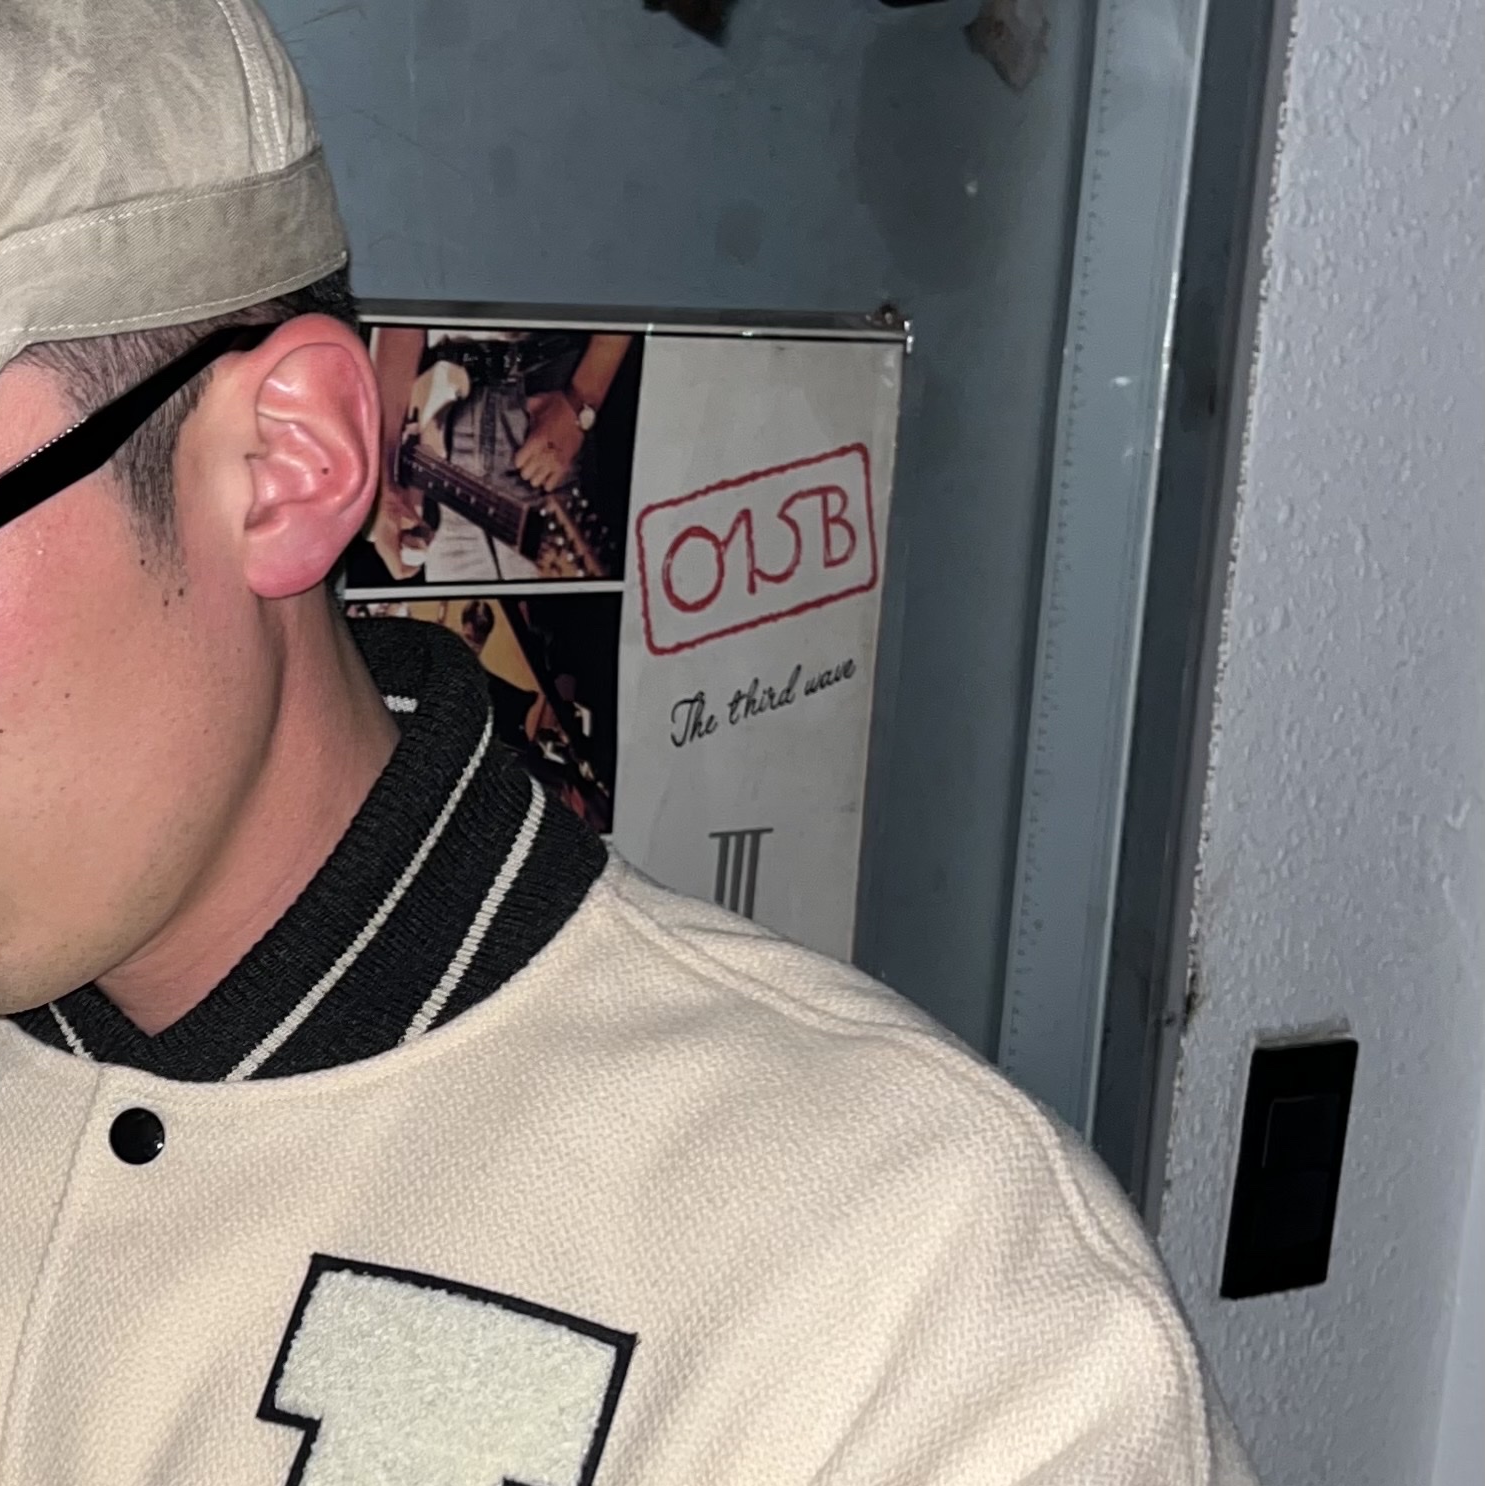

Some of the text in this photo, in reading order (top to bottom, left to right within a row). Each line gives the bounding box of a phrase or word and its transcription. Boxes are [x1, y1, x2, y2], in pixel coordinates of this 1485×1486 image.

[670, 658, 856, 748] The third wave
